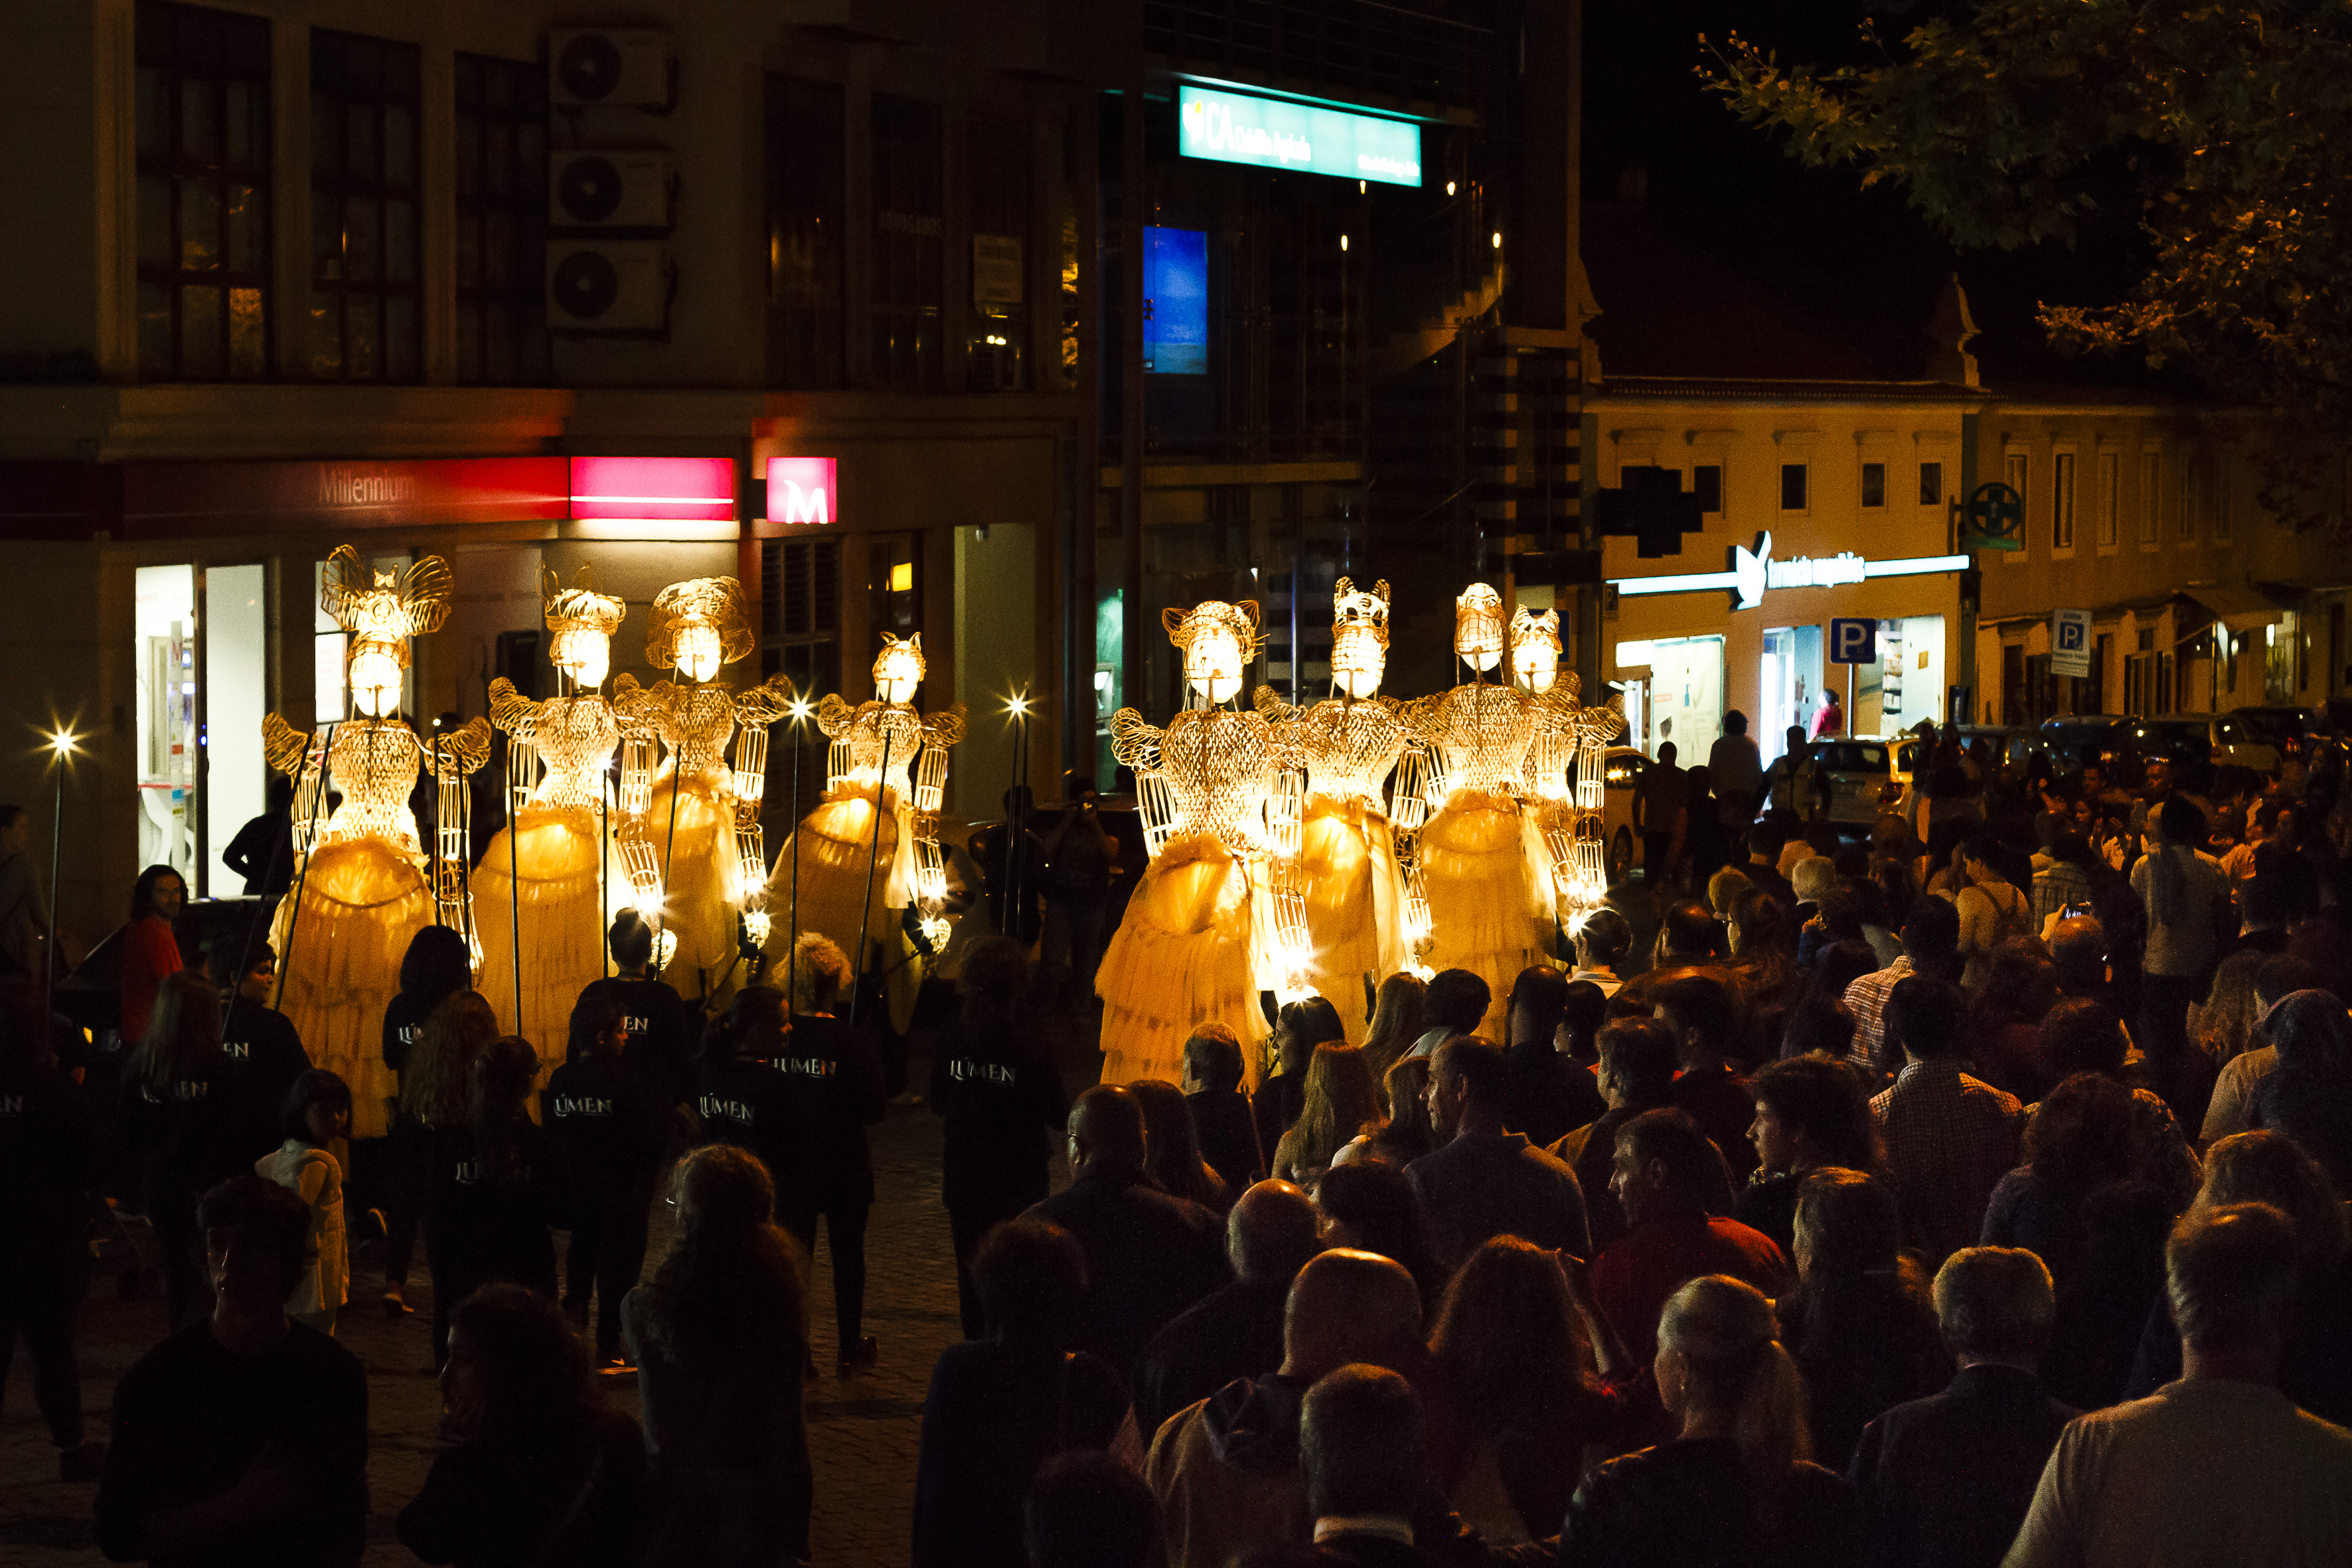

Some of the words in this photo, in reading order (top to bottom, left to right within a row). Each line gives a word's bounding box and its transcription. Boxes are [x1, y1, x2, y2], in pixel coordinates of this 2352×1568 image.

[1206, 102, 1235, 151] CA
[319, 462, 414, 505] Millennium
[784, 479, 828, 524] M
[1840, 623, 1867, 659] P
[2064, 625, 2078, 647] P
[950, 1057, 1016, 1085] LÚMEN
[699, 1092, 755, 1123] LÚMEN
